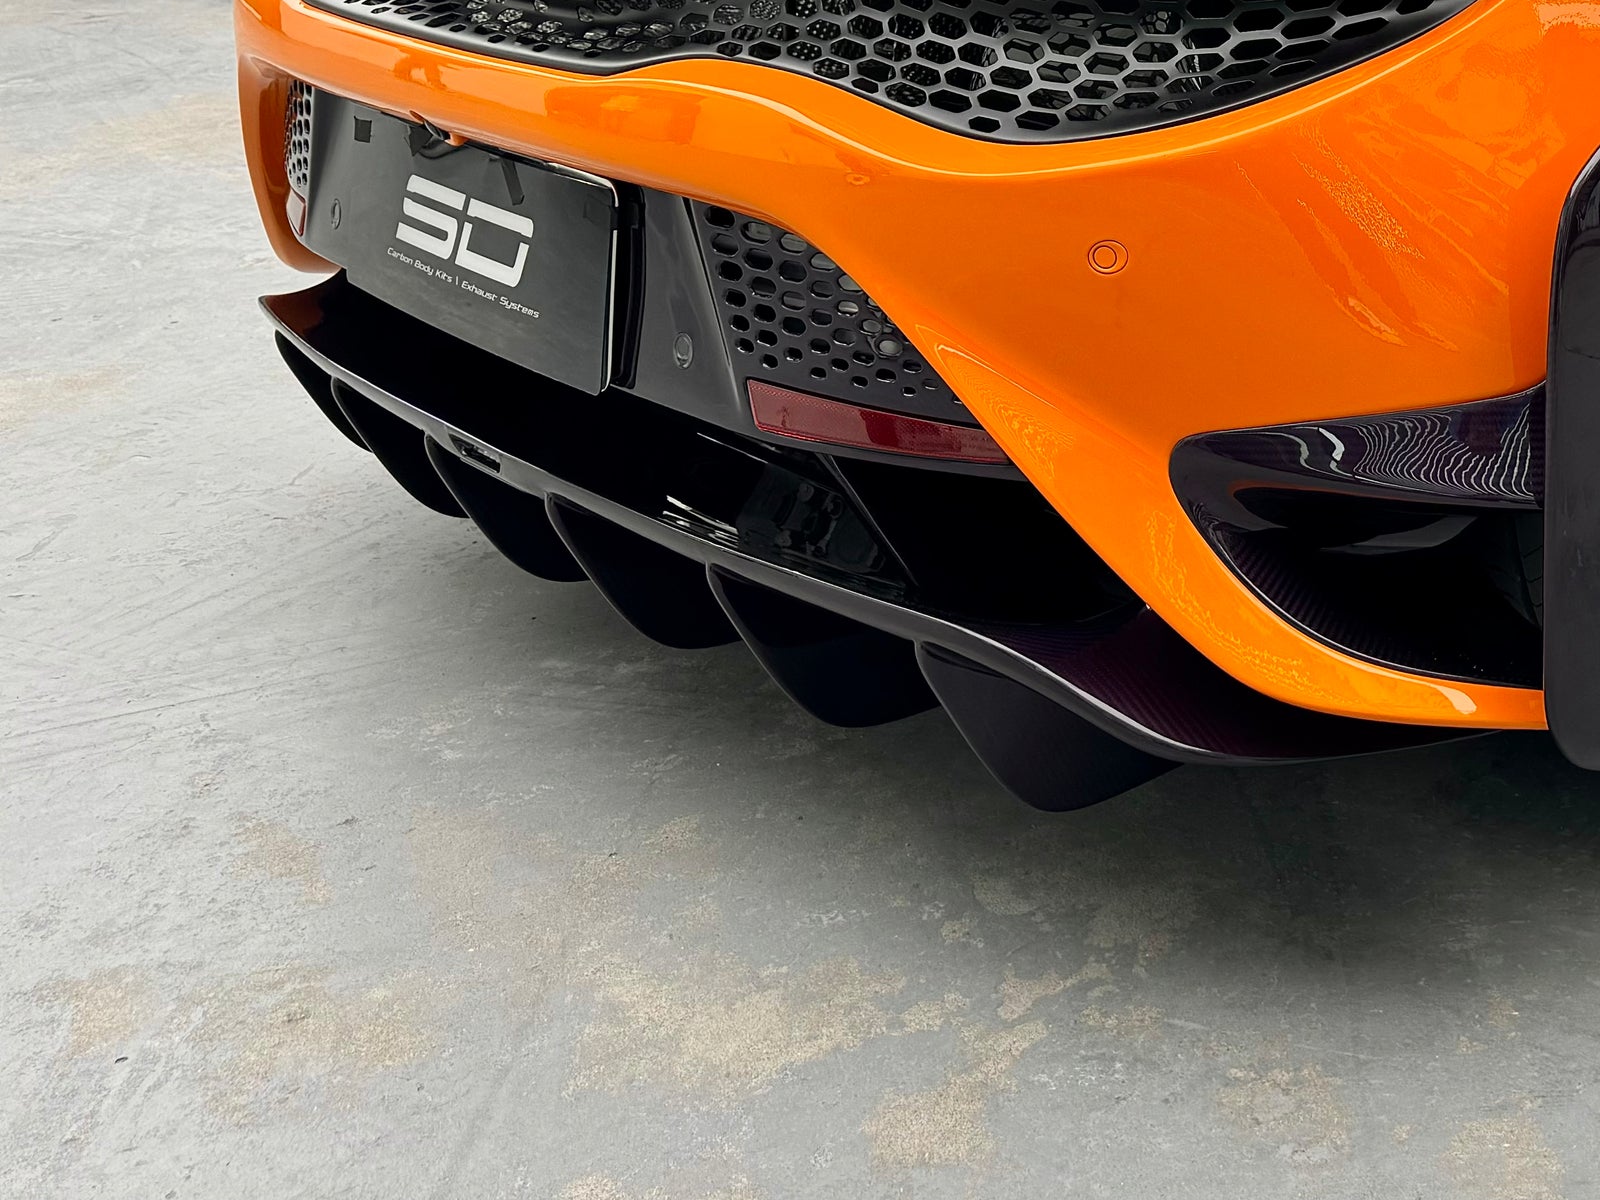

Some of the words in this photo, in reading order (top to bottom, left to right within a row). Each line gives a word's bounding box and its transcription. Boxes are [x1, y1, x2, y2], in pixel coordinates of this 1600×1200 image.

[387, 247, 413, 265] Carbon
[414, 259, 434, 277] Body
[435, 269, 453, 283] Kits
[461, 280, 498, 302] Exhaust
[499, 296, 540, 319] Systems
